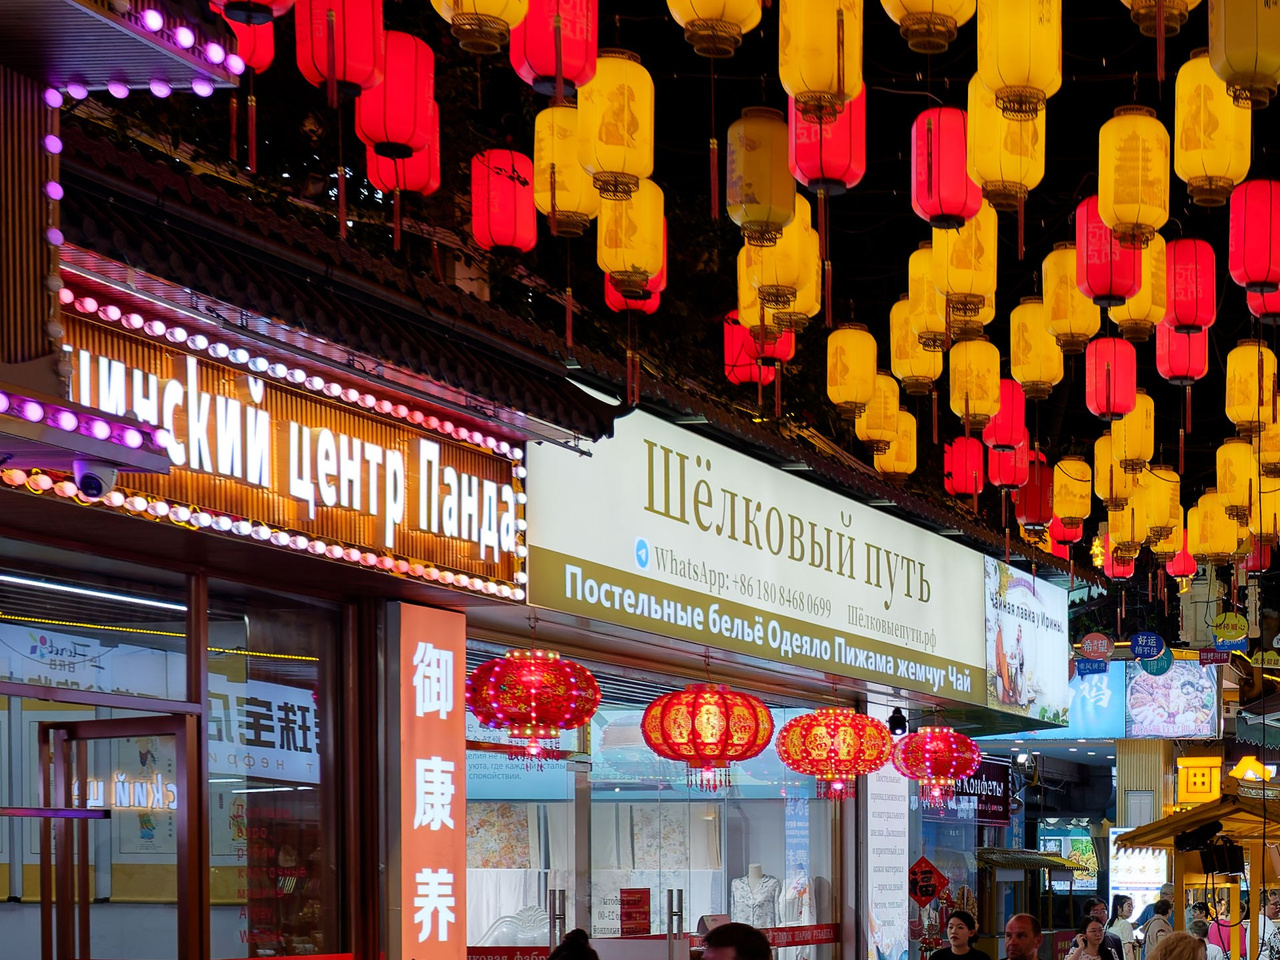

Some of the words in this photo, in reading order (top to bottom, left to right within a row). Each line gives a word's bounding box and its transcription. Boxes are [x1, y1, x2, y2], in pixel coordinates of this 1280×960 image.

[288, 420, 405, 548] центр
[418, 438, 517, 563] Панда
[643, 438, 856, 580] Шёлковый
[865, 541, 932, 611] путь
[654, 545, 731, 596] WhatsApp:
[732, 573, 754, 597] +86
[756, 578, 777, 603] 180
[779, 583, 805, 611] 8468
[807, 590, 832, 619] 0699
[563, 564, 704, 630] Постельные
[708, 602, 764, 646] бельё
[767, 626, 831, 667] Одеяло
[834, 639, 895, 676] Пижама
[896, 657, 946, 694] жемчуг
[948, 663, 971, 693] Чай
[1016, 605, 1035, 624] лавка
[1137, 635, 1156, 646] 好运
[468, 763, 489, 771] уюта,
[490, 764, 503, 772] где
[468, 772, 522, 780] спокойствии.
[412, 641, 456, 944] 御康养
[963, 774, 1004, 797] Конфеты
[910, 869, 937, 898] 福
